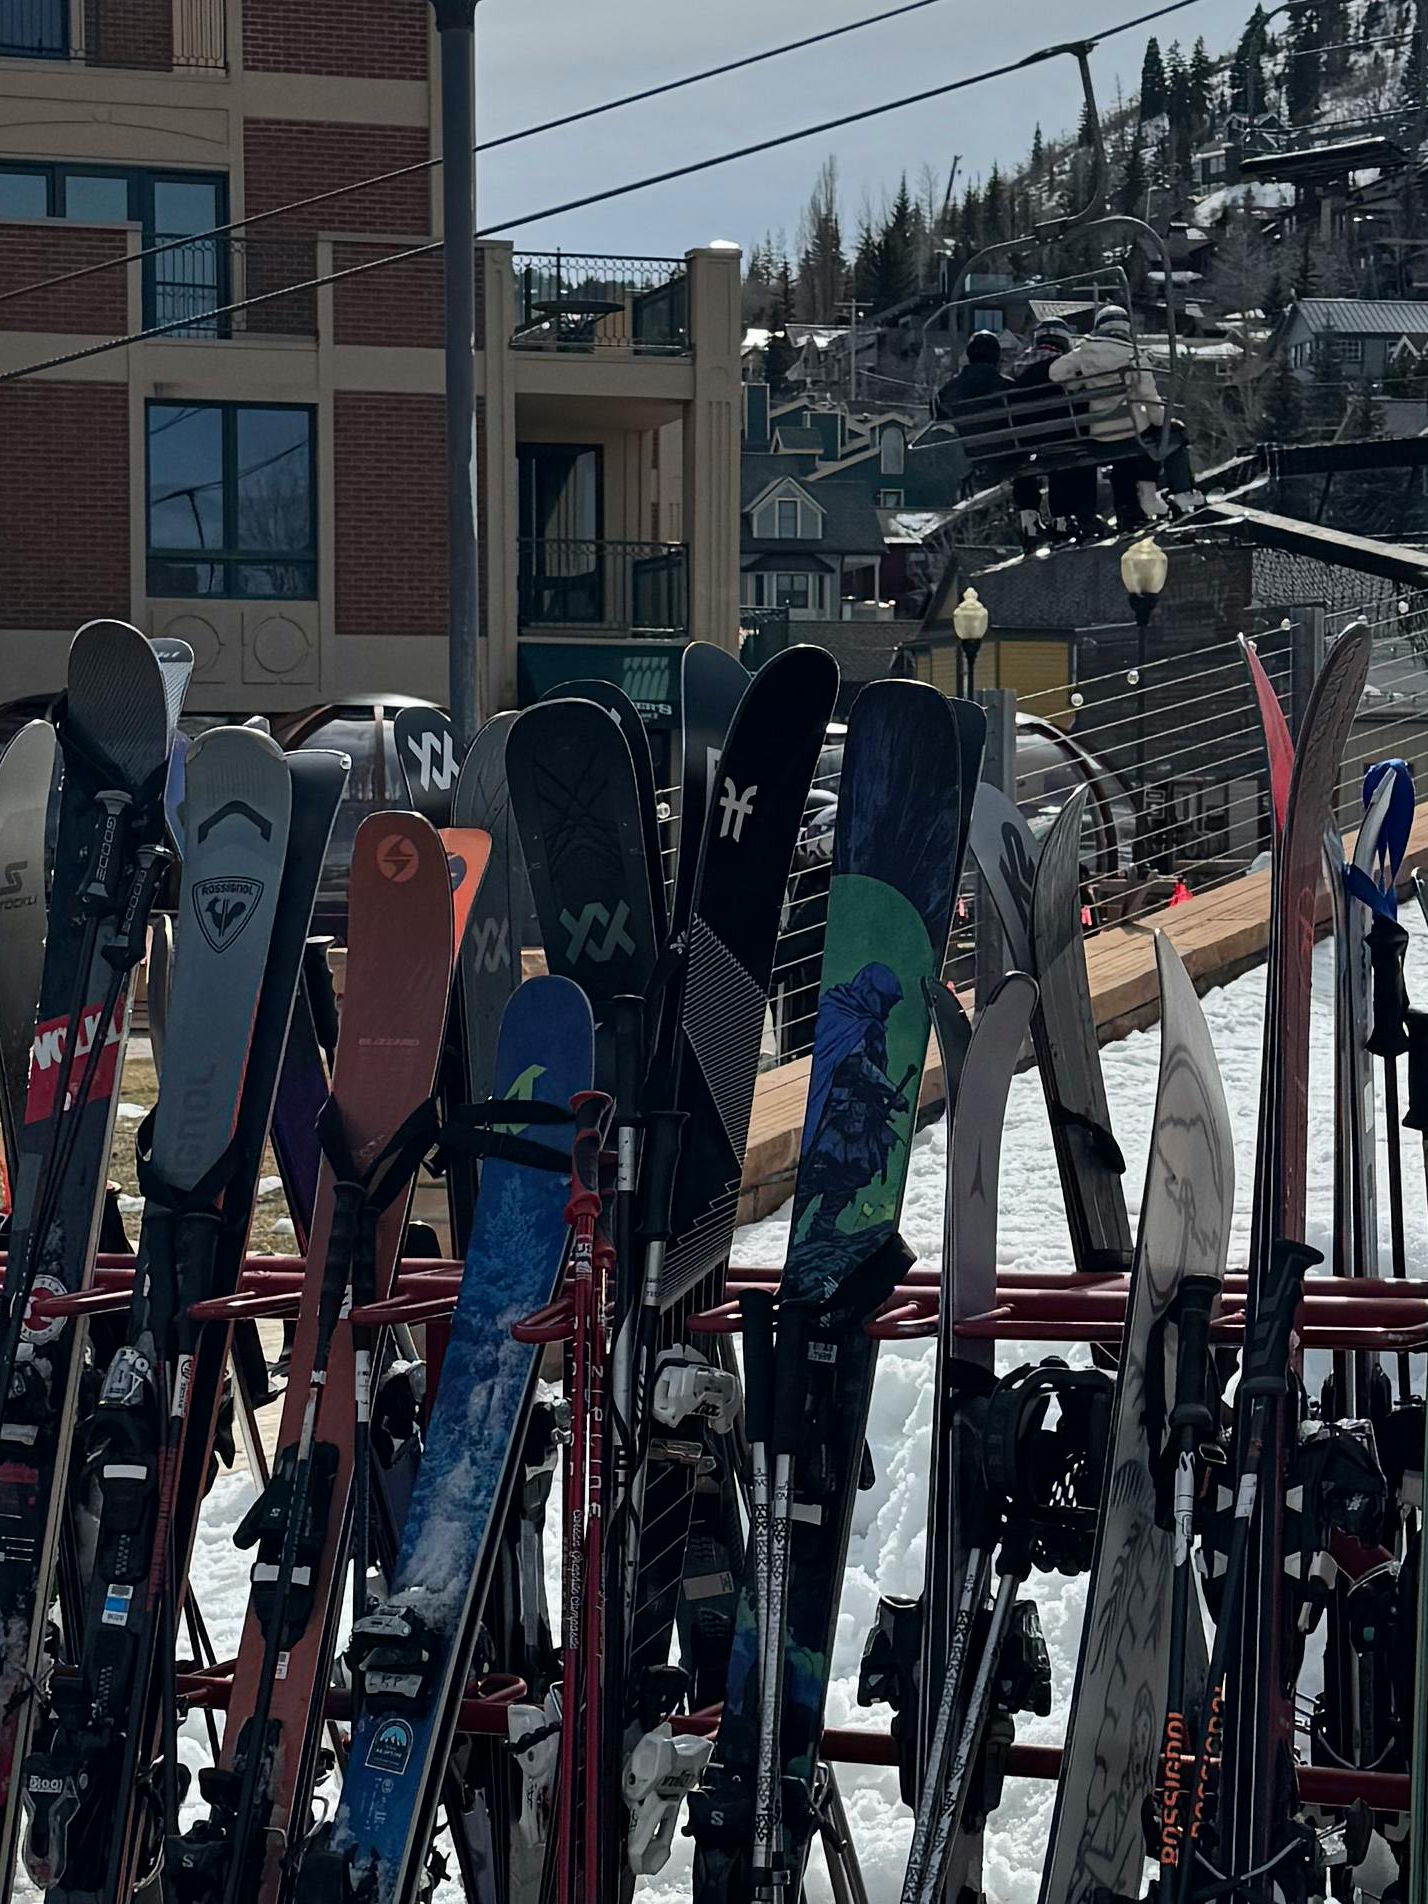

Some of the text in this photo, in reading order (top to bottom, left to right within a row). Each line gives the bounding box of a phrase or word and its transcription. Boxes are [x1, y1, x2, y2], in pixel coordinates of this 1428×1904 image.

[201, 881, 254, 896] ROSSIGNOL
[358, 1037, 420, 1046] BLIZZARD
[588, 1364, 604, 1520] ZIPLINE
